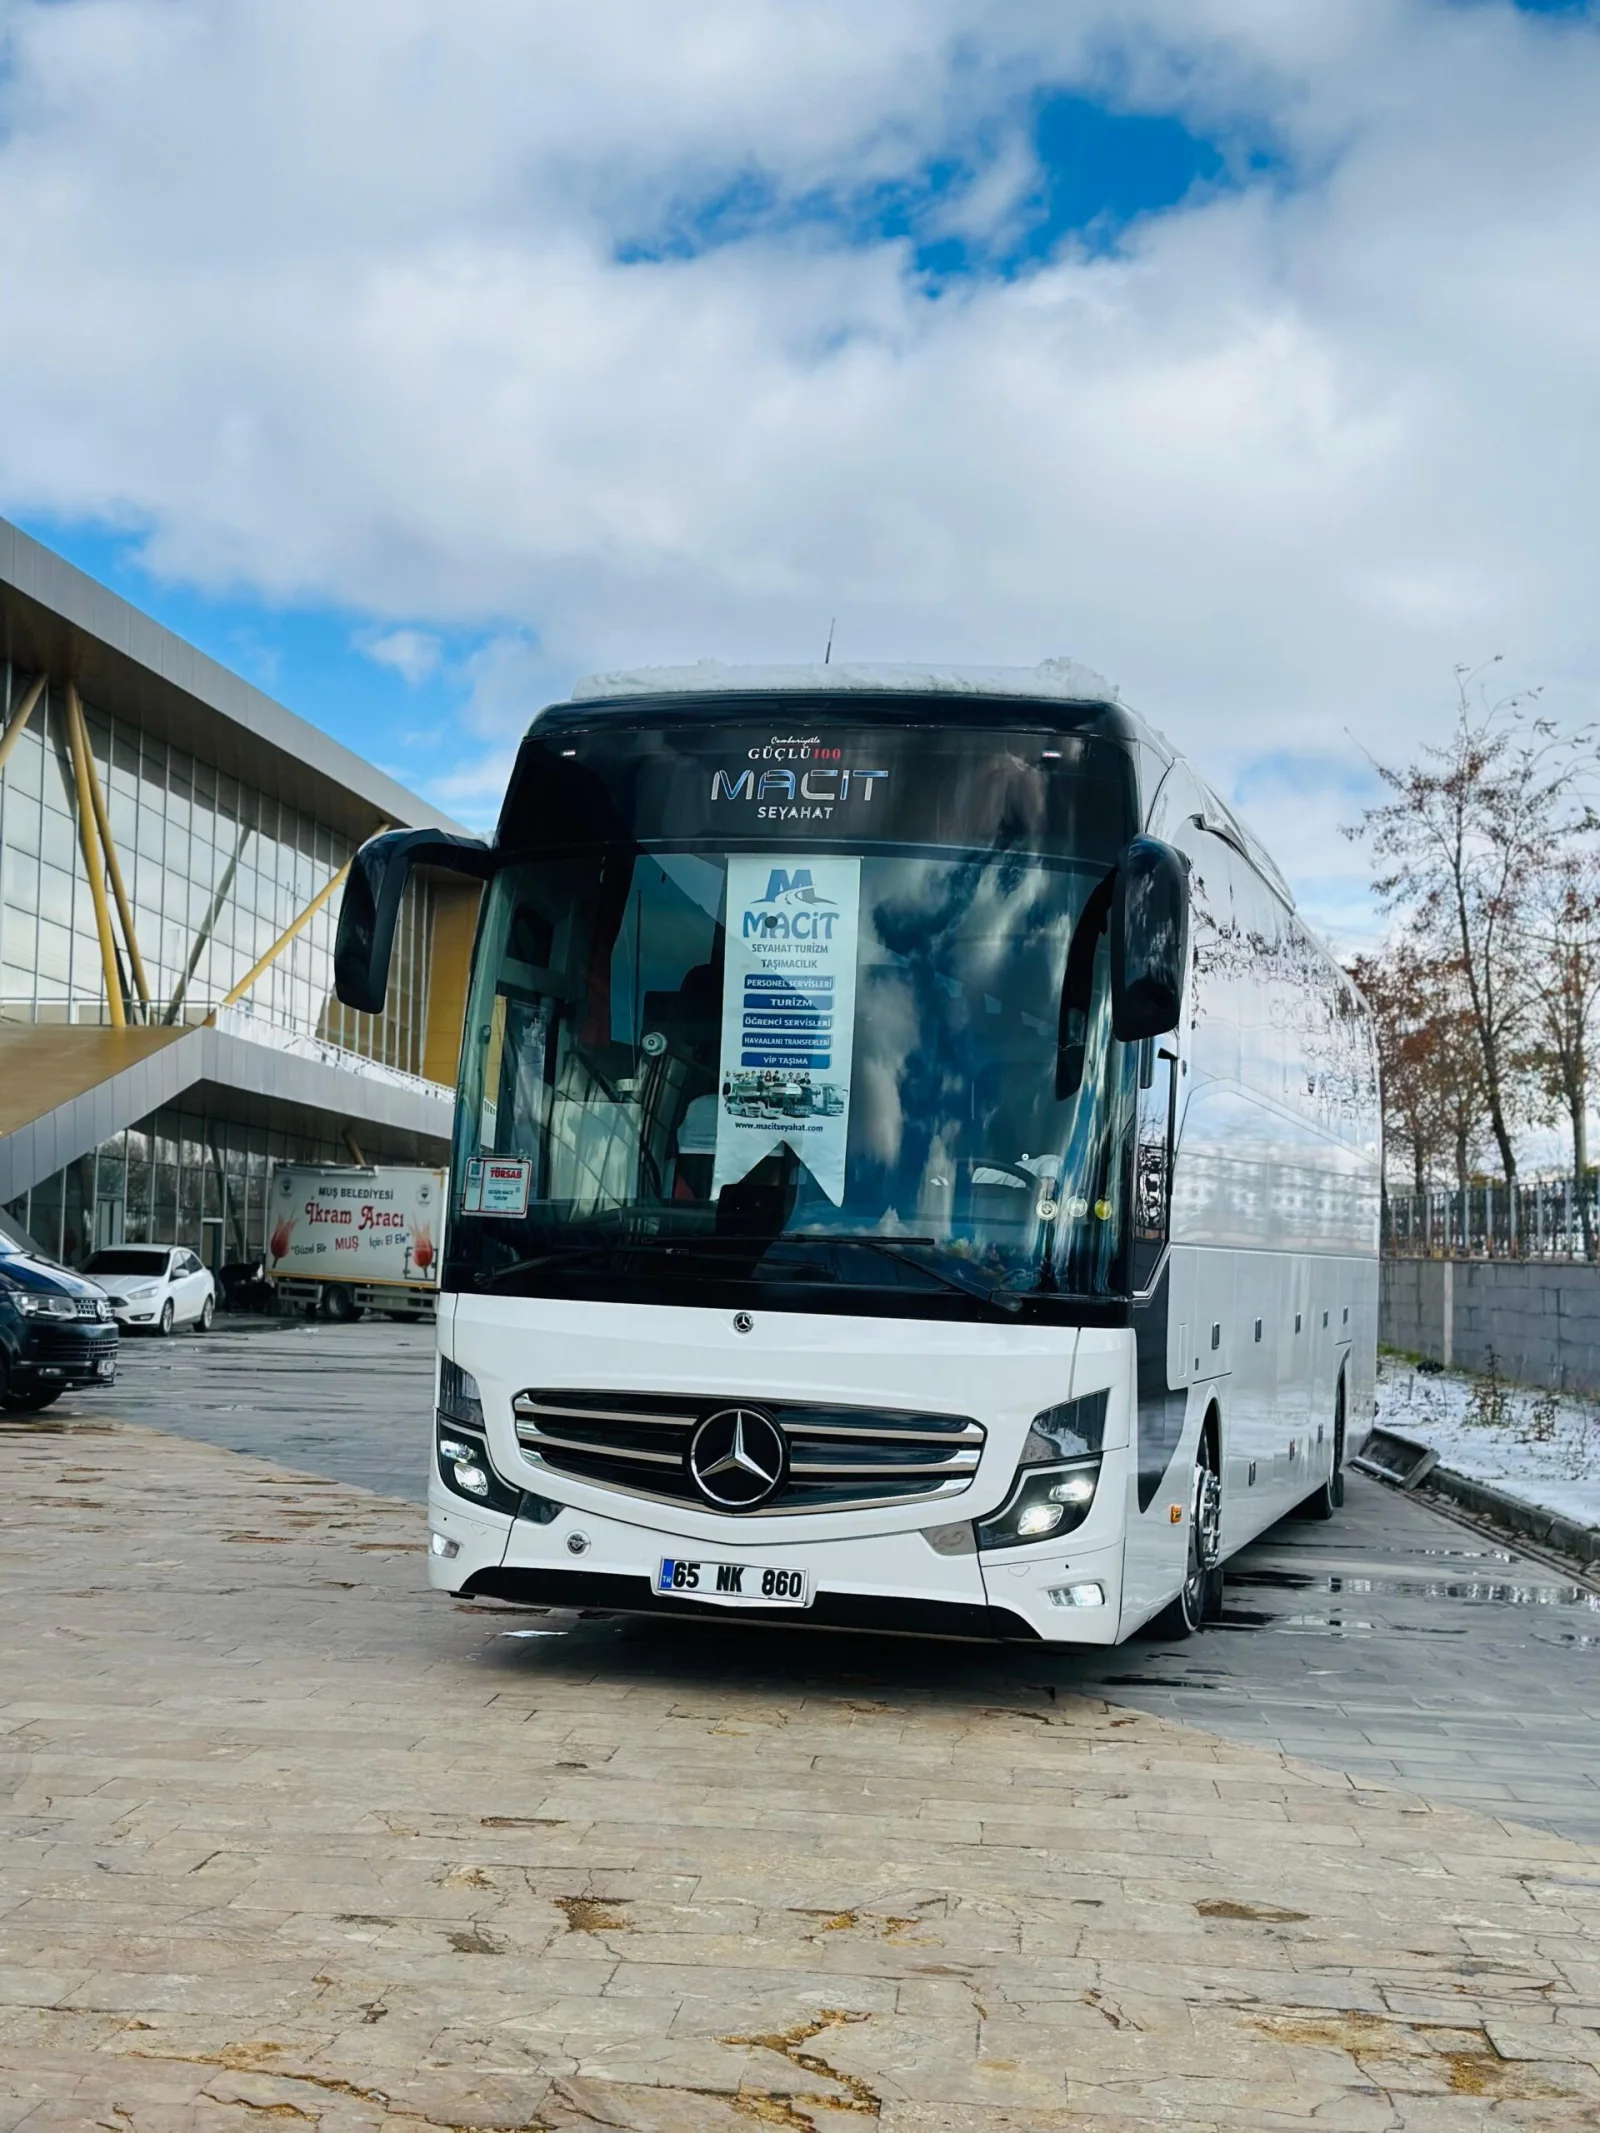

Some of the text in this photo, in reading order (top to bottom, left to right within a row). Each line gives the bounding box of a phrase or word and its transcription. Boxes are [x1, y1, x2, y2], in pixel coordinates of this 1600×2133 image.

[748, 745, 841, 761] GÜÇLÜ 100
[757, 806, 833, 820] SEYAHAT
[751, 942, 828, 953] SEYAHAT TURİZM
[761, 958, 818, 970] TAŞIMACILIK
[746, 978, 832, 988] PERSONEL SERVİSLERİ
[770, 997, 813, 1007] TURİZM
[744, 1015, 831, 1027] ÖĞRENCİ SERVİSLERİ
[744, 1037, 783, 1045] HAVAALANI
[763, 1055, 808, 1066] VİP TAŞIMA
[735, 1121, 824, 1133] www.macitseyahat.com
[318, 1186, 394, 1200] MUŞ BELEDİYESİ
[305, 1197, 404, 1231] İkram Aracı
[335, 1235, 360, 1252] MUŞ
[662, 1575, 673, 1584] TR
[673, 1562, 803, 1598] 65 NK 860
